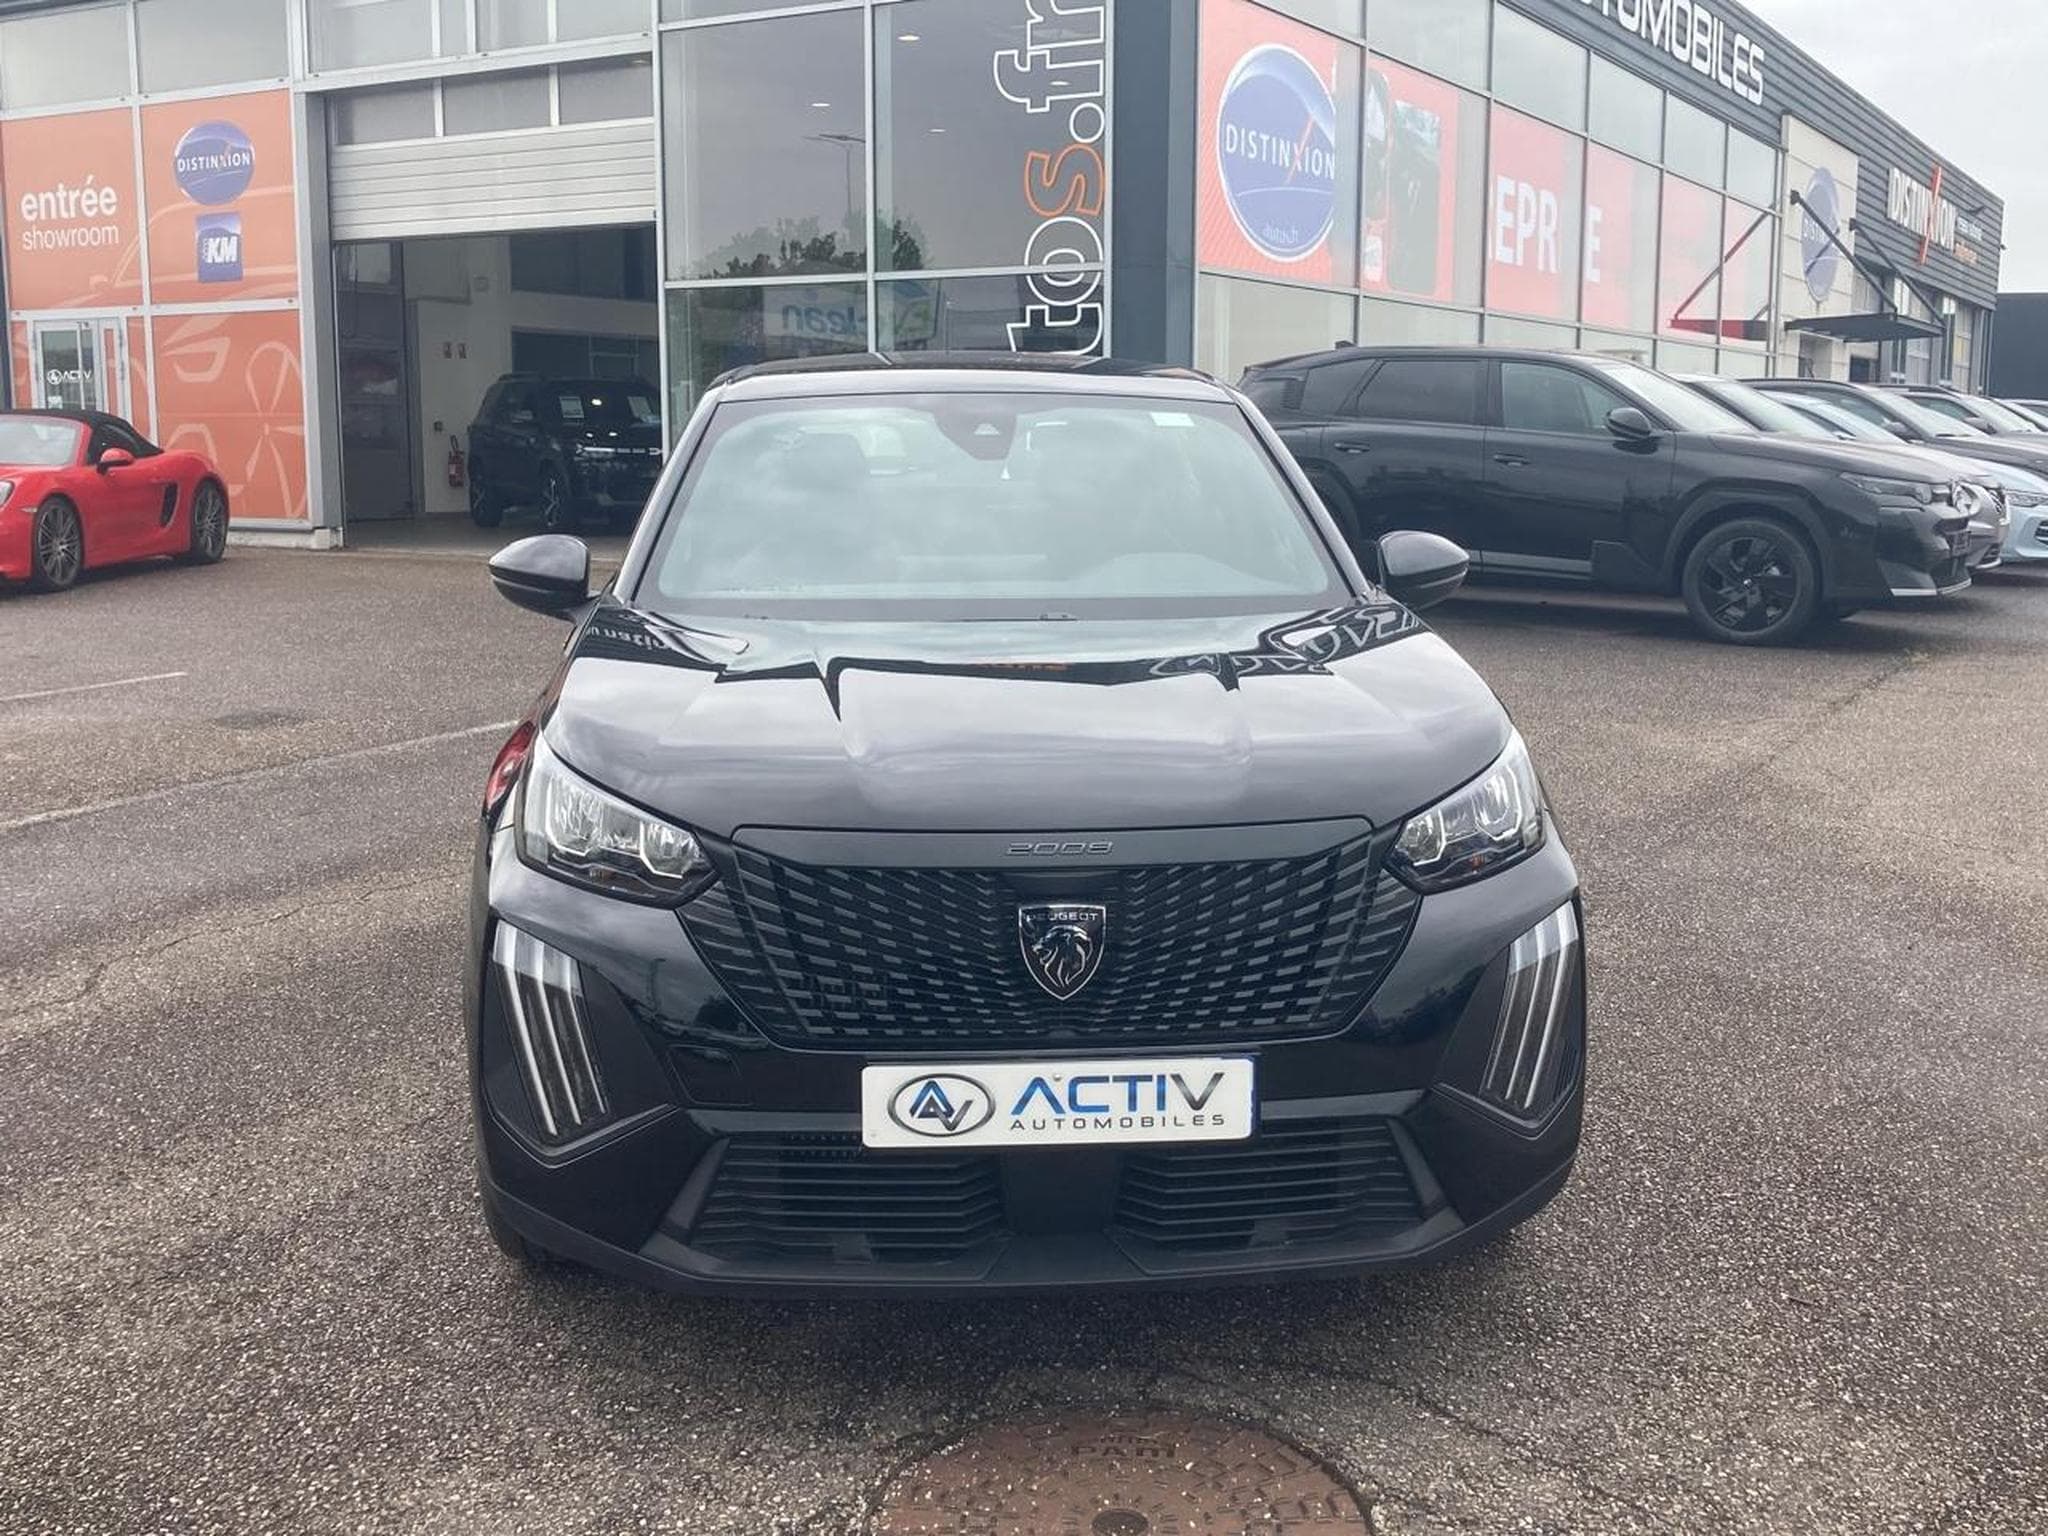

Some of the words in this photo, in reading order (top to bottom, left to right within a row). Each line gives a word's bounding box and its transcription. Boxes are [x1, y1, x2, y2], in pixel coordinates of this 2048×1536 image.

[176, 150, 252, 172] DISTINXION
[1224, 120, 1335, 182] DISTINXION
[20, 174, 118, 222] entrée
[21, 223, 119, 251] showroom
[1007, 842, 1113, 856] 2008
[1010, 1072, 1226, 1116] ACTIV
[1010, 1114, 1226, 1131] AUTOMOBILES
